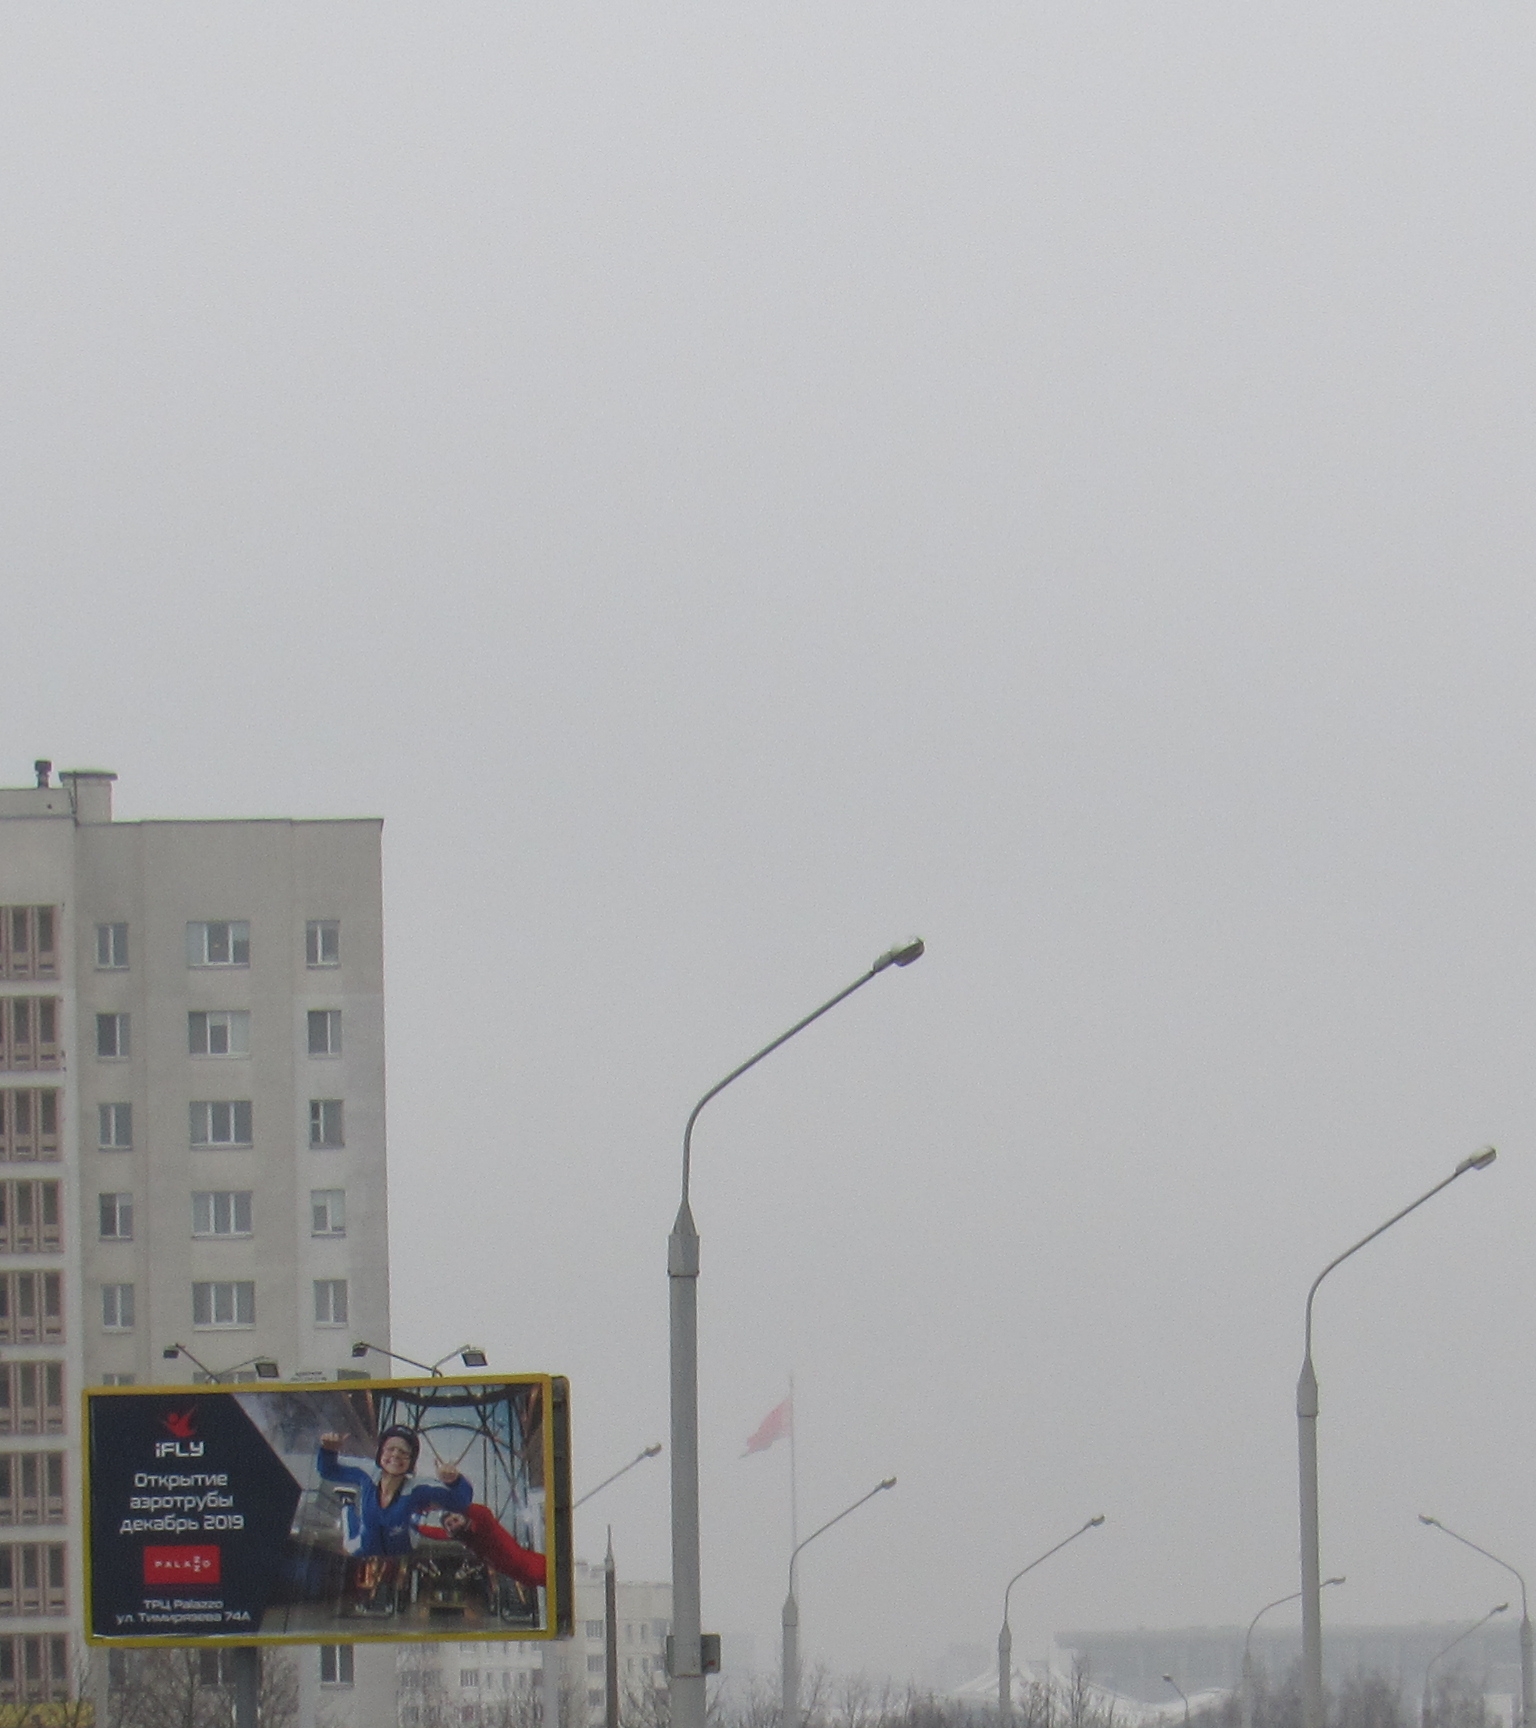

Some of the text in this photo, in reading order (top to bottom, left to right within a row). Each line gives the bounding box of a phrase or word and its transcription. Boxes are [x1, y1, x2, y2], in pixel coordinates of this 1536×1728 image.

[155, 1441, 204, 1458] iFLY
[134, 1473, 228, 1490] Открытие
[130, 1490, 234, 1512] аэротрубы
[119, 1513, 244, 1534] декабрь 2019
[144, 1599, 224, 1611] ТРЦ Palazzo
